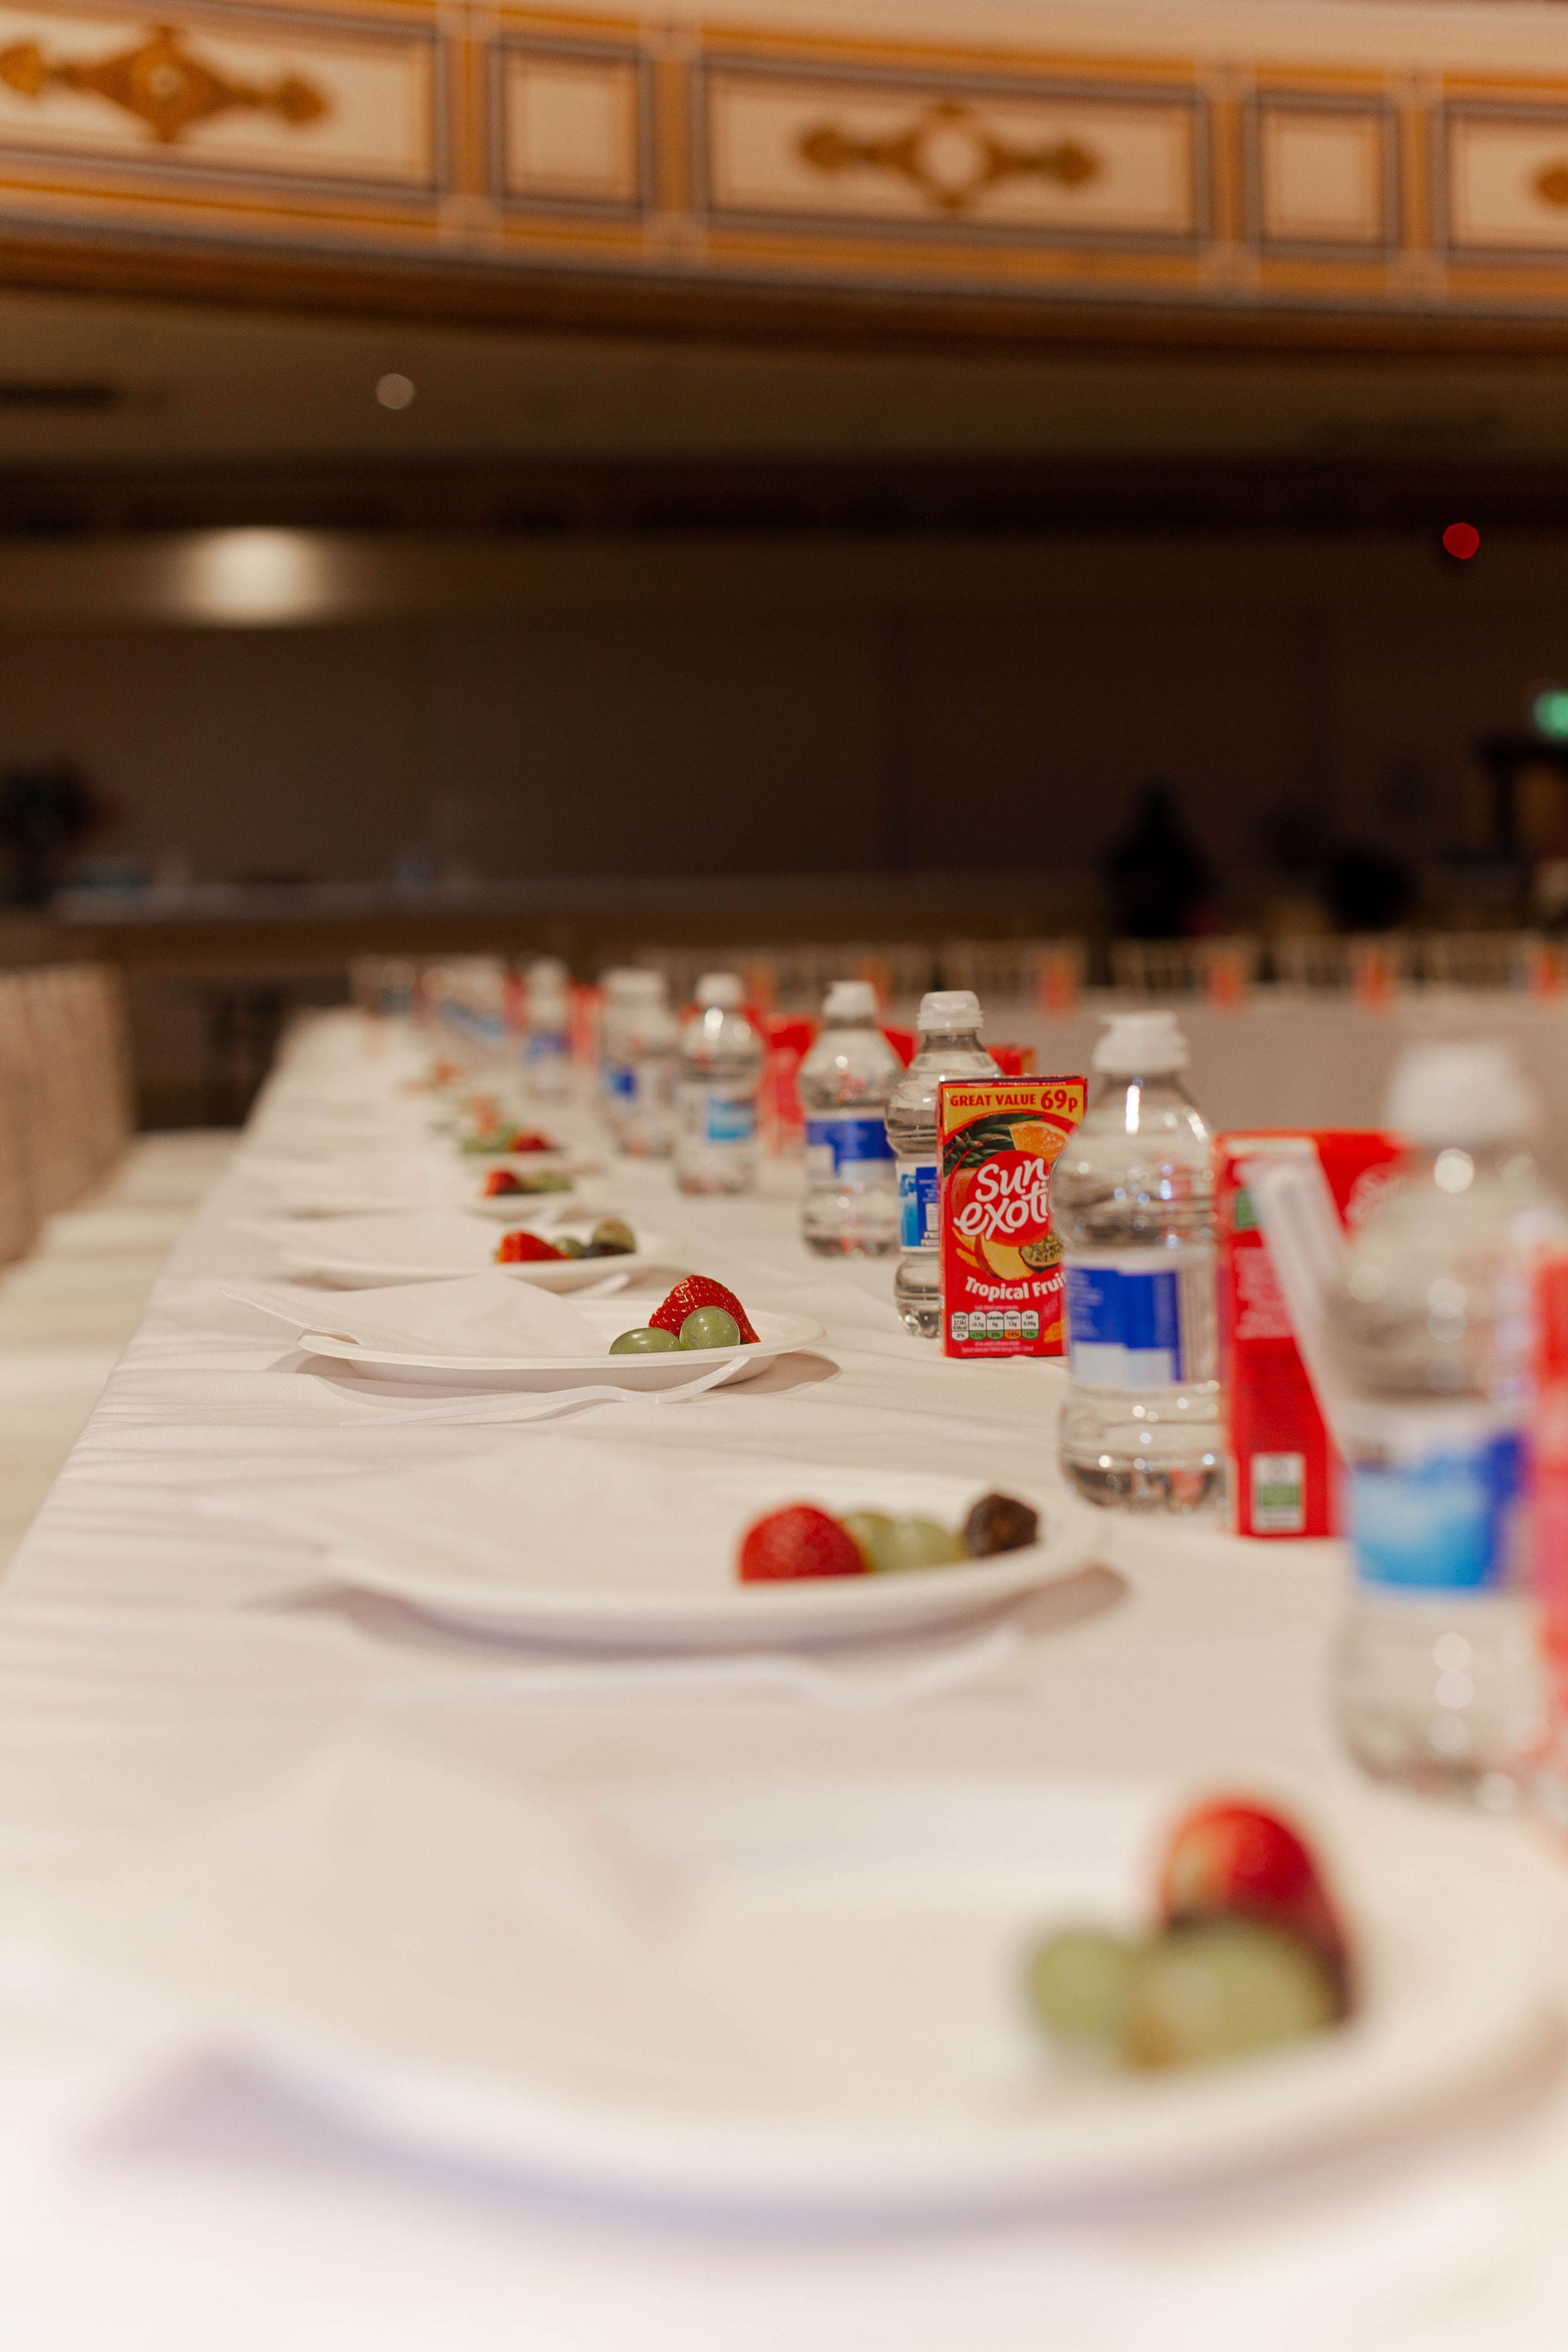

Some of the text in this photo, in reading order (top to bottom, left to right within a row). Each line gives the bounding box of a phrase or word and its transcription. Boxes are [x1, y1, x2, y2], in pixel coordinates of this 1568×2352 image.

[950, 1089, 1078, 1112] GREAT VALUE 69p
[975, 1158, 1050, 1202] Sun
[953, 1181, 1048, 1240] exoti
[965, 1276, 1030, 1302] Tropical
